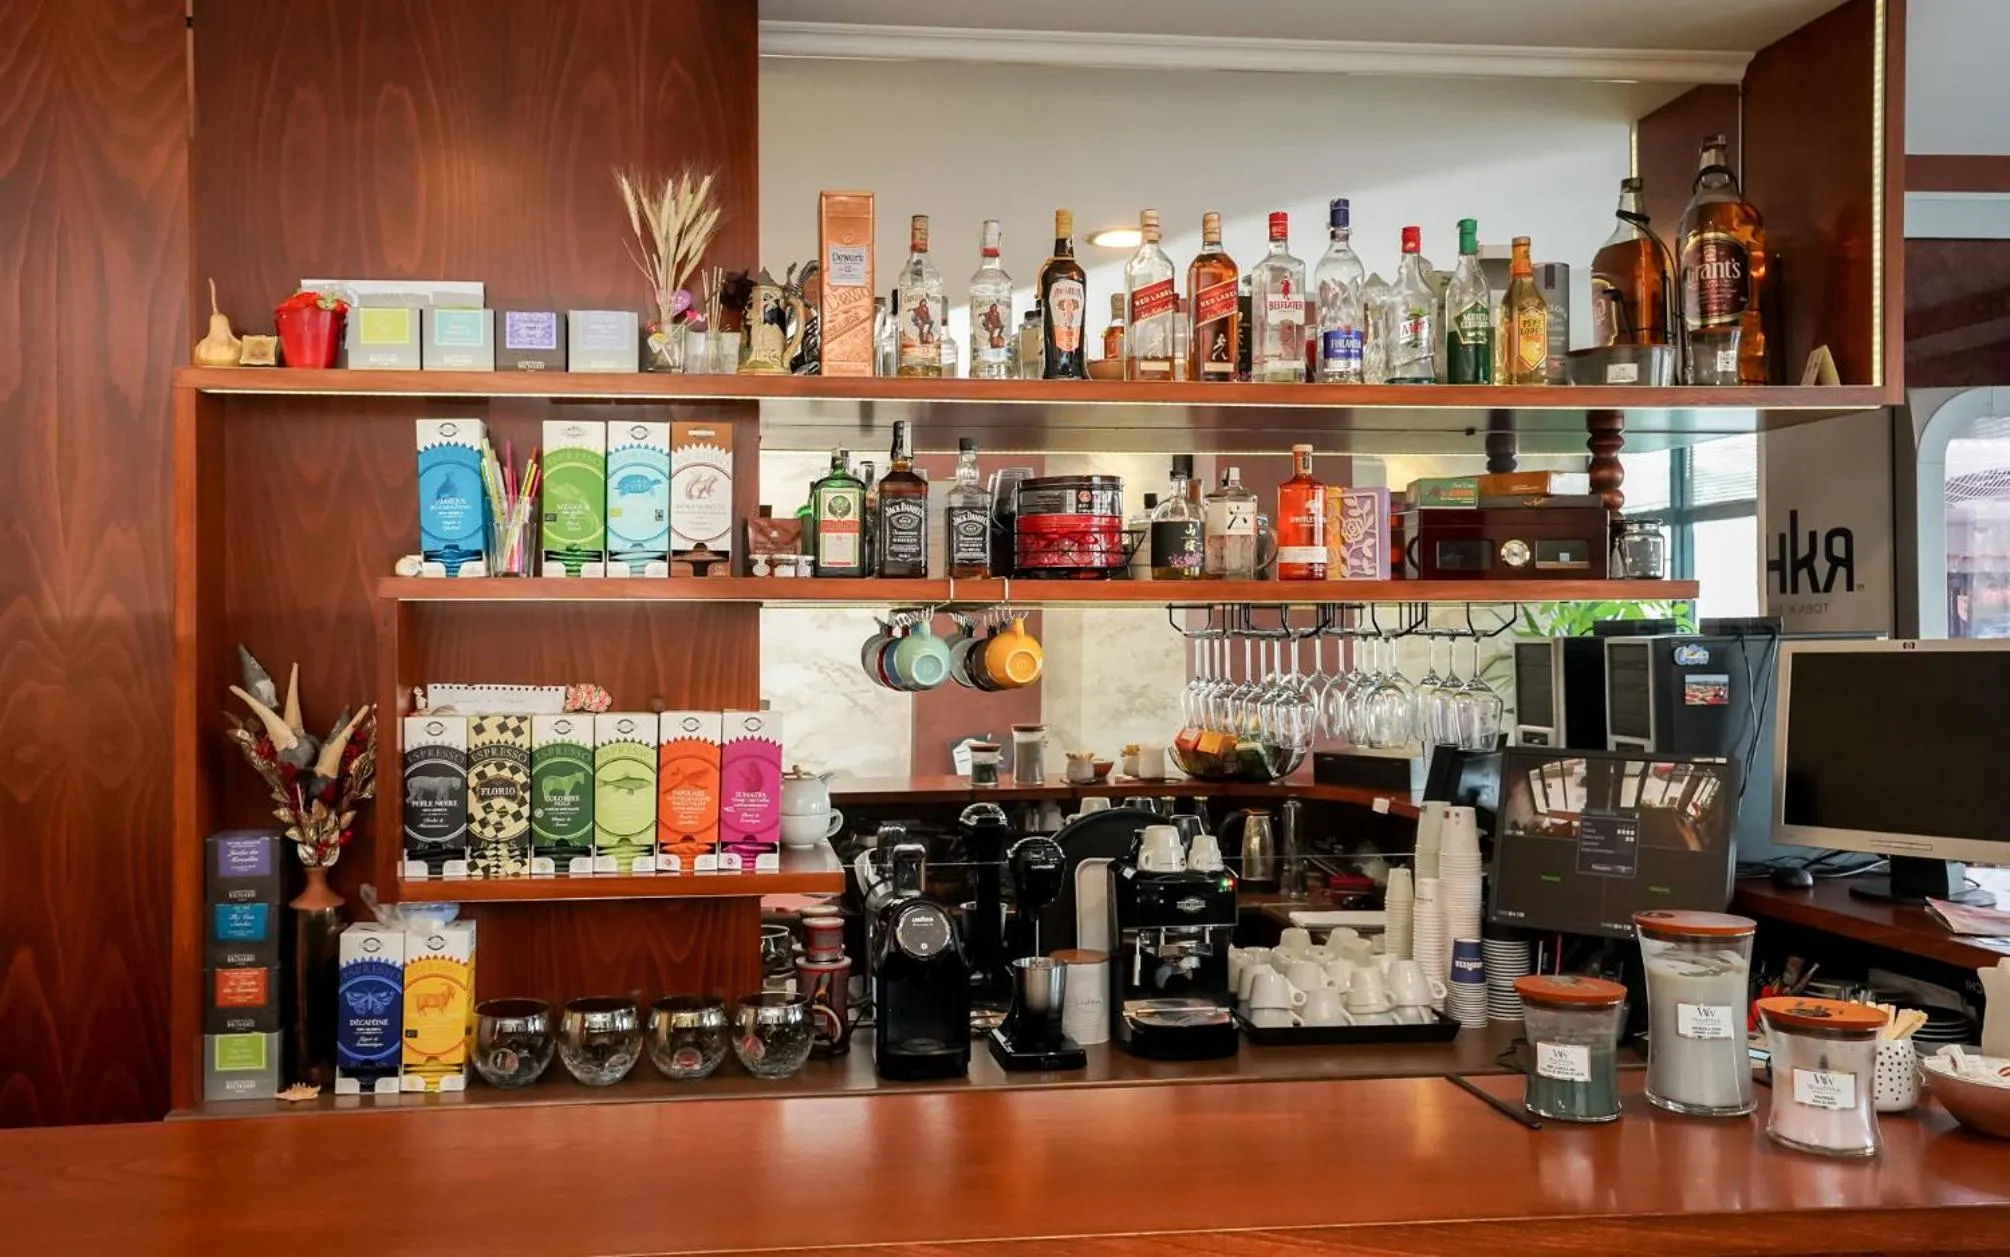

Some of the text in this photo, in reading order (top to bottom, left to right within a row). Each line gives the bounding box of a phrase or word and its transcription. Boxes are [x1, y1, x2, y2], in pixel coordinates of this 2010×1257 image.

[1134, 289, 1174, 307] RED LABEL
[1216, 290, 1238, 303] LABEL
[1268, 300, 1303, 312] BEEFEATER
[470, 747, 528, 763] ESPRESSO
[481, 786, 516, 796] FLORIO
